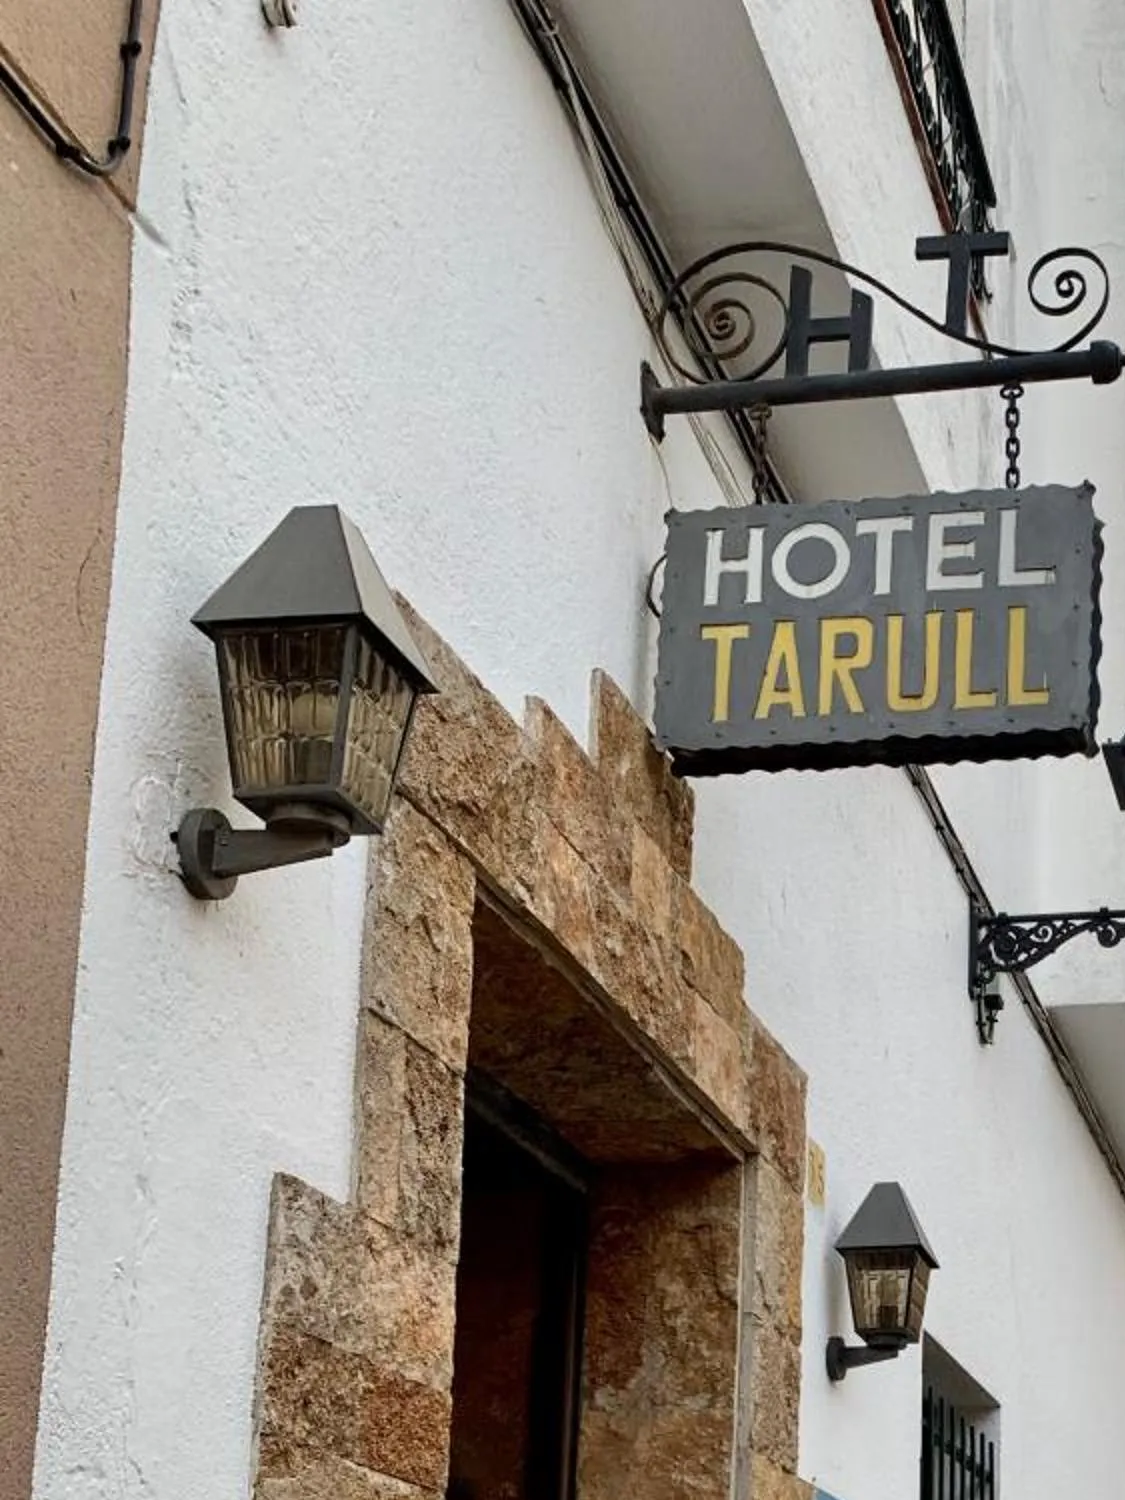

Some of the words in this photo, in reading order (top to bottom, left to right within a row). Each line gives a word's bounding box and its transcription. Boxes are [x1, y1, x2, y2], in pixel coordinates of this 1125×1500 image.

[785, 265, 874, 379] H
[702, 508, 1057, 607] HOTEL
[700, 606, 1051, 723] TARULL
